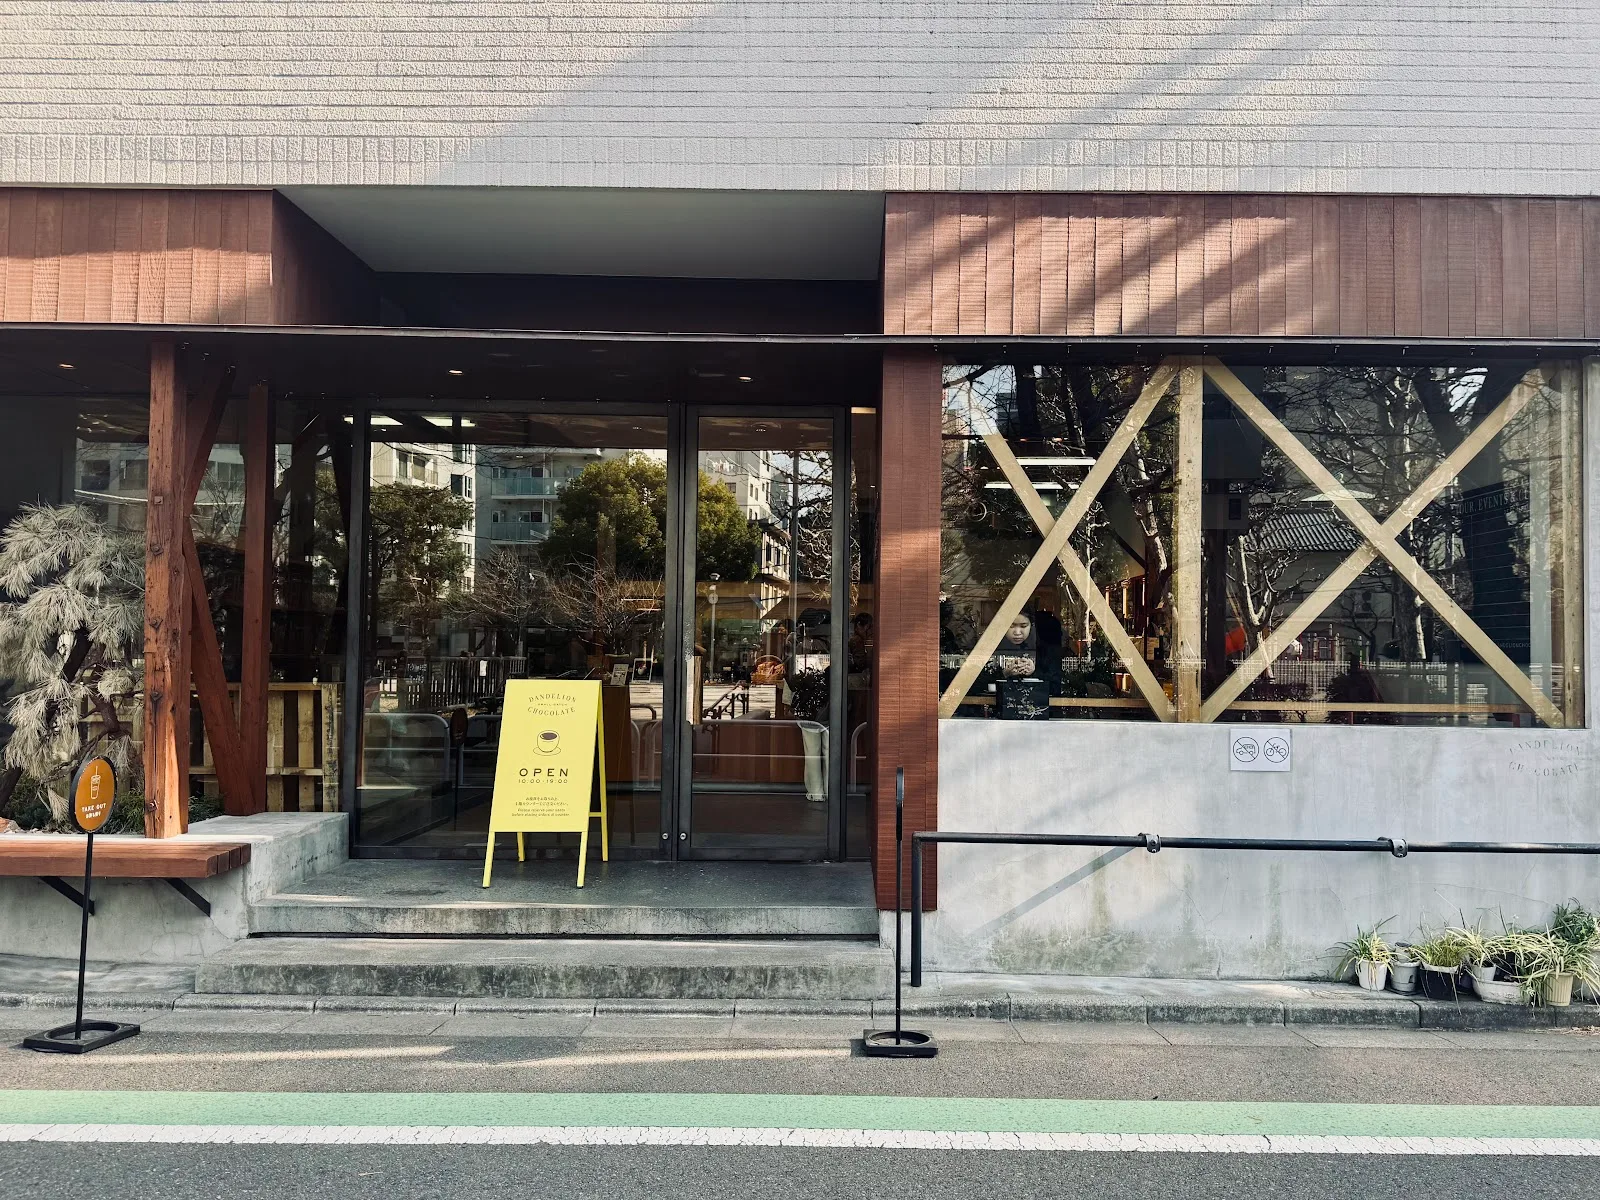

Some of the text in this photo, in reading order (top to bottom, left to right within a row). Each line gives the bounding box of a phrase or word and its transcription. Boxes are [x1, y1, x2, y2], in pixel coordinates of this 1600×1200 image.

[528, 693, 577, 703] DANDELION
[527, 706, 576, 717] CHOCOLATE
[519, 767, 569, 777] OPEN
[81, 802, 107, 813] TAKE OUT
